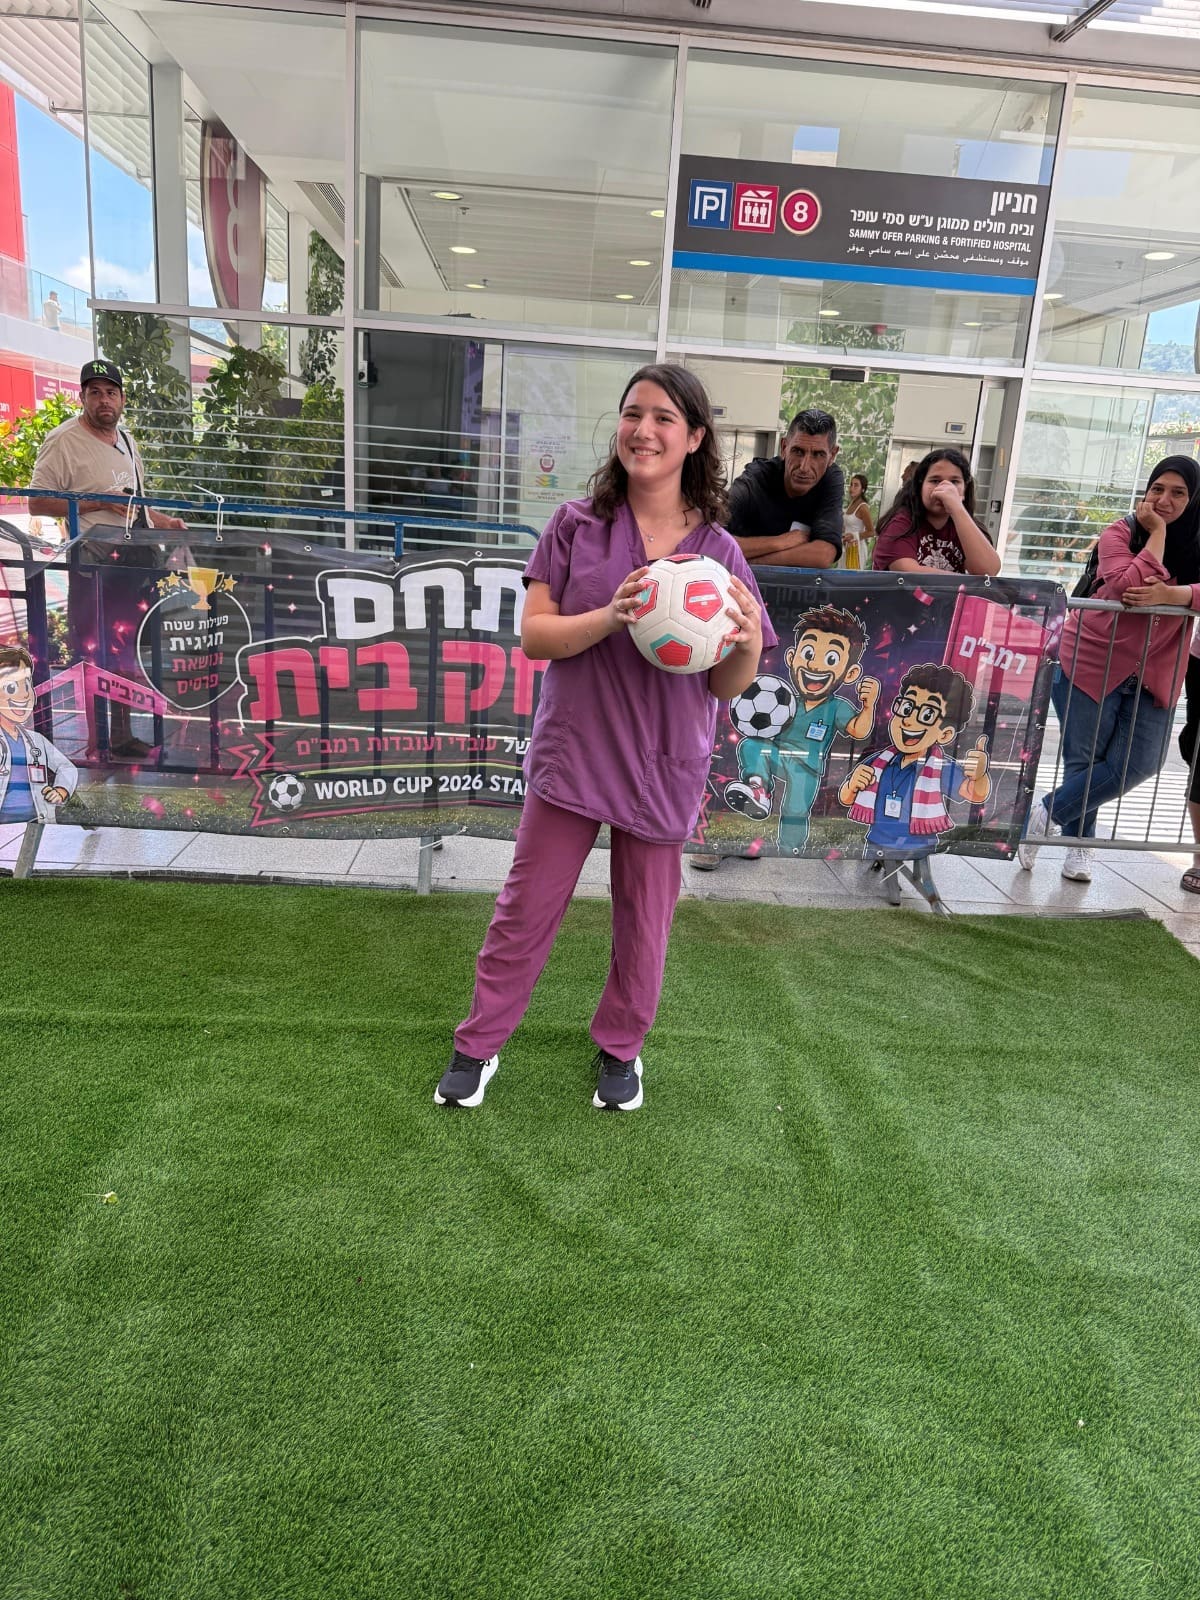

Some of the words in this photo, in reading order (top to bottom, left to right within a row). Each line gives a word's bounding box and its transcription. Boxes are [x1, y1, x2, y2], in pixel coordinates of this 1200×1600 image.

[701, 194, 720, 220] P
[792, 200, 809, 223] 8
[990, 191, 1038, 217] חניון
[850, 209, 878, 223] עופר
[882, 211, 905, 225] סמי
[937, 216, 970, 231] ממוגן
[973, 218, 1005, 234] חולים
[1008, 222, 1034, 236] ובית
[849, 228, 880, 240] SAMMY
[882, 231, 903, 242] OFER
[905, 233, 940, 245] PARKING
[942, 236, 949, 245] &
[951, 236, 991, 249] FORTIFIED
[993, 240, 1032, 252] HOSPITAL
[868, 246, 891, 258] سامي
[894, 247, 912, 256] اسم
[915, 249, 930, 259] على
[327, 567, 528, 639] תחם
[163, 620, 195, 631] שטח
[198, 615, 229, 630] פעילות
[169, 631, 224, 651] חגיגית
[172, 652, 224, 673] ונושאת
[959, 635, 1027, 675] רמב"ם
[176, 673, 219, 695] פרסים
[247, 640, 418, 722] בית
[97, 676, 156, 708] רמב"ם
[296, 737, 360, 756] רמב"ם
[367, 736, 443, 752] ועובדות
[448, 736, 497, 752] עובדי
[503, 736, 532, 755] של
[314, 778, 387, 800] WORLD
[399, 777, 433, 794] CUP
[438, 774, 484, 793] 2026
[489, 776, 529, 796] STA
